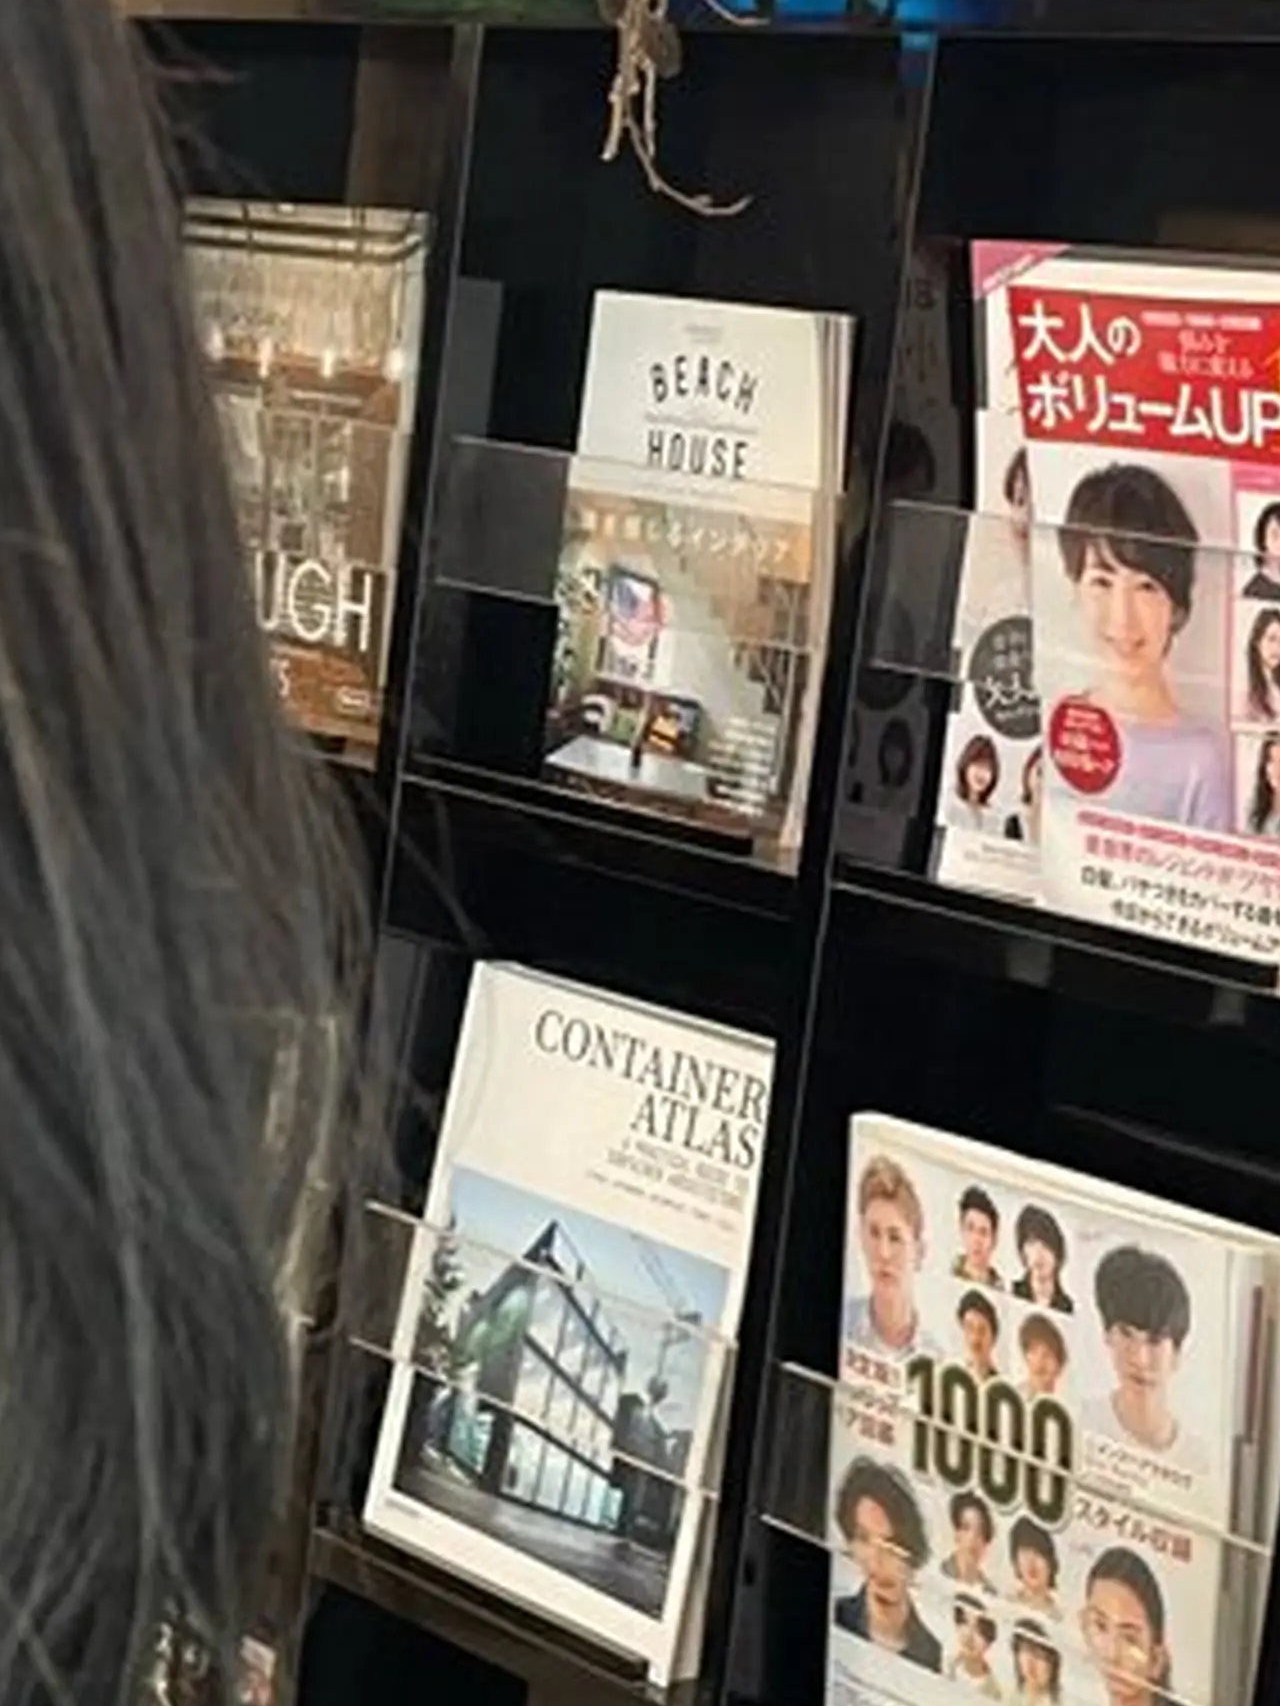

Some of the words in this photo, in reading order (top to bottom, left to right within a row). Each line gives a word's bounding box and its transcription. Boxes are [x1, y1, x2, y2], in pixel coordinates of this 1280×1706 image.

[1017, 299, 1141, 366] 大人の
[649, 354, 758, 414] BEACH
[647, 429, 750, 480] HOUSE
[533, 1008, 768, 1125] CONTAINER
[629, 1092, 760, 1172] ATLAS
[906, 1354, 1072, 1524] 1000
